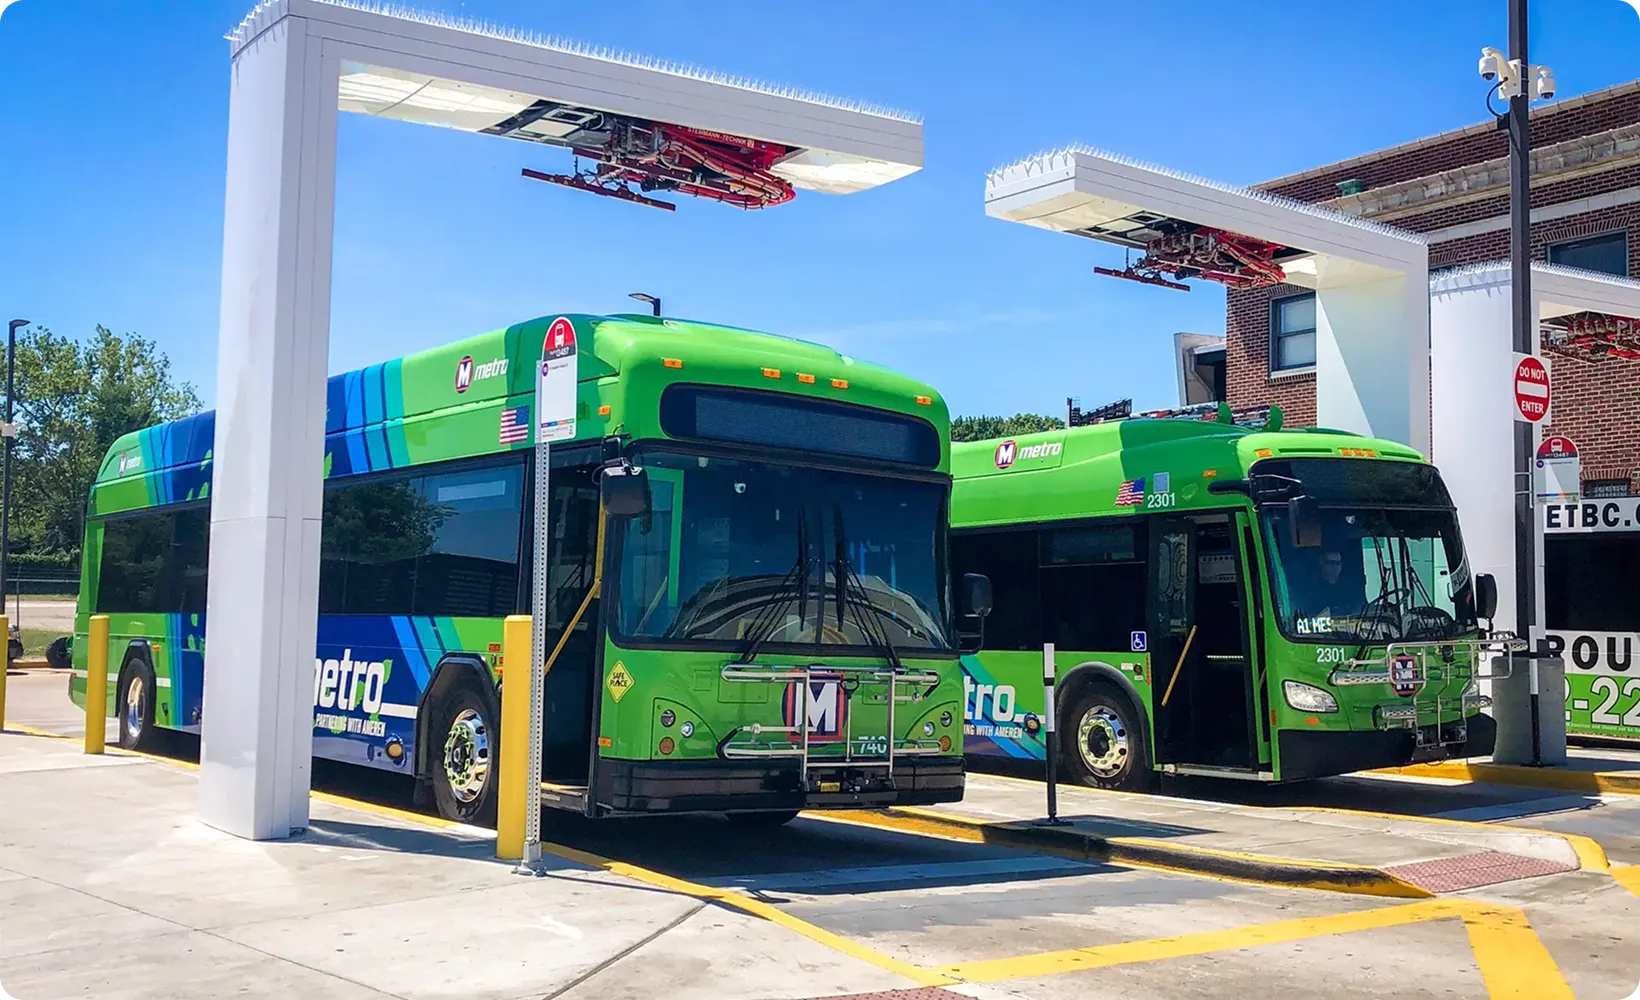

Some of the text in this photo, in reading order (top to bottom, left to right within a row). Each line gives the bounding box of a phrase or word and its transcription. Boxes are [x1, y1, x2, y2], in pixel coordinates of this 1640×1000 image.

[687, 127, 747, 145] STEMMANN-TECHNIK
[474, 357, 509, 381] metro
[1519, 366, 1545, 380] DO NOT
[1521, 400, 1544, 414] ENTER
[1018, 441, 1062, 459] metro
[1147, 492, 1176, 508] 2301
[1546, 502, 1640, 528] ETBC.
[1316, 646, 1346, 663] 2301
[610, 679, 628, 688] PLACE
[612, 671, 625, 680] SAFE
[1565, 675, 1640, 727] -22
[347, 717, 362, 733] WITH
[976, 725, 994, 737] WITH
[994, 725, 1023, 739] AMEREN
